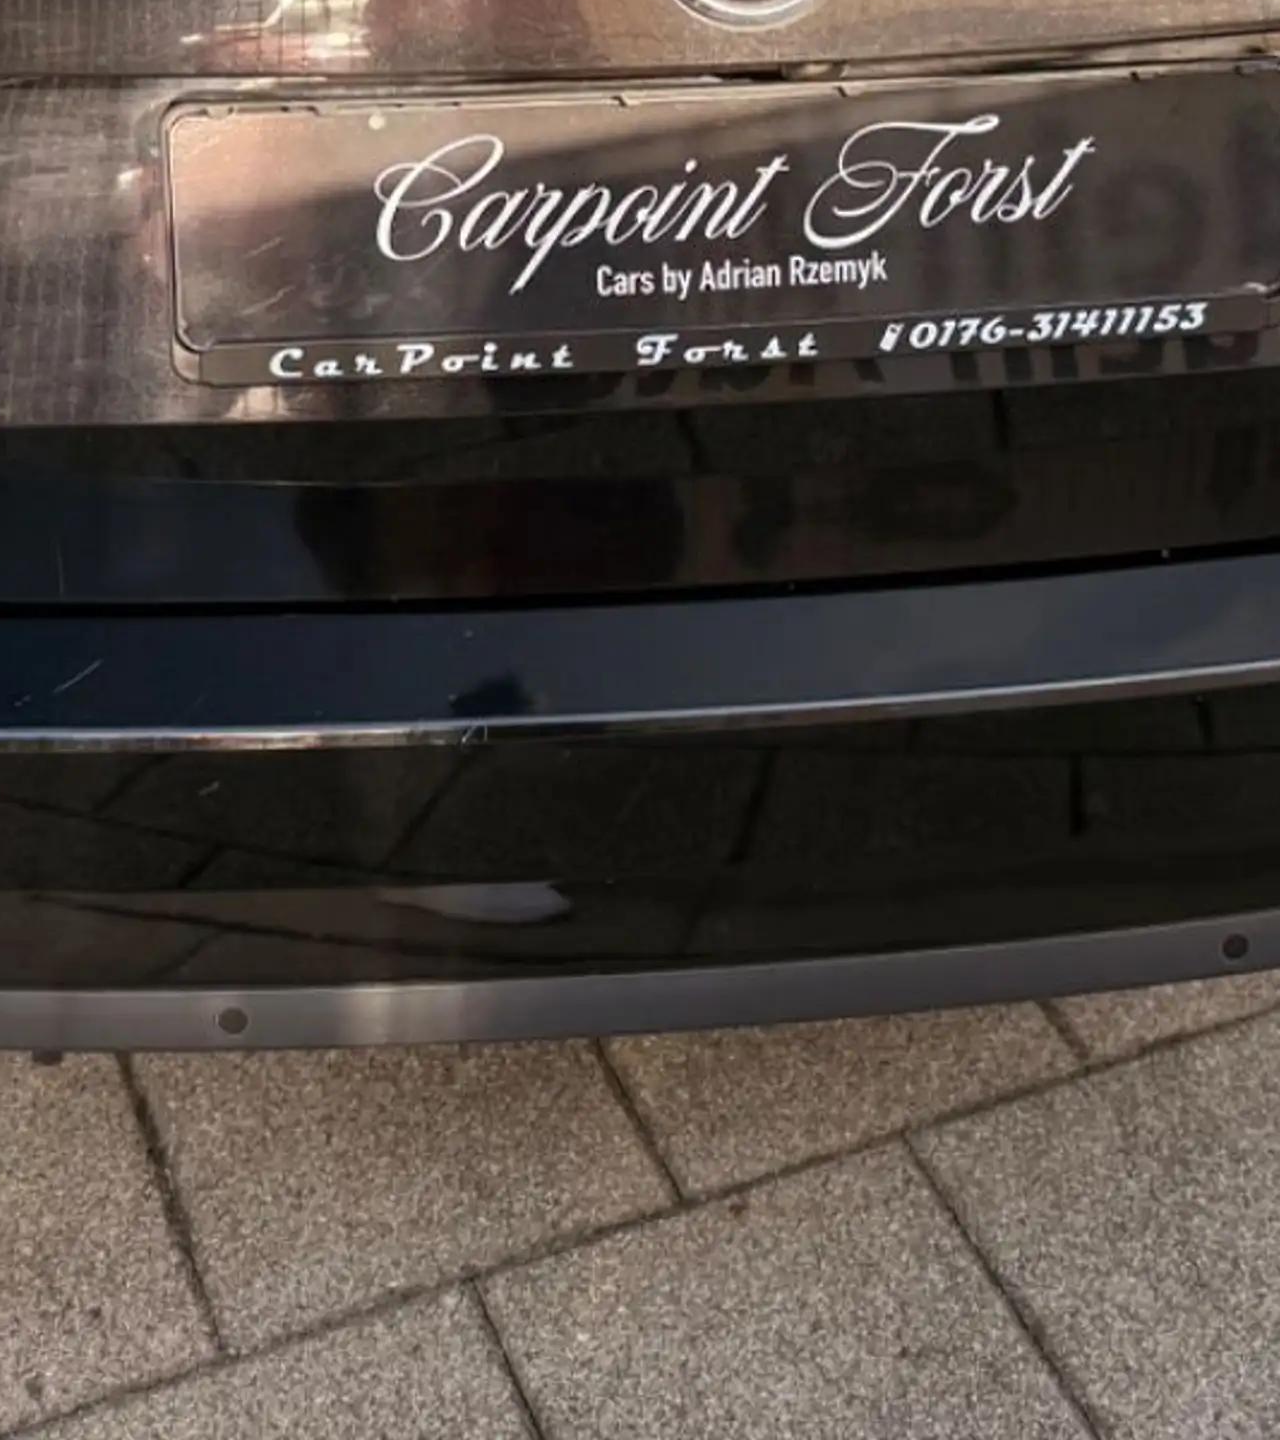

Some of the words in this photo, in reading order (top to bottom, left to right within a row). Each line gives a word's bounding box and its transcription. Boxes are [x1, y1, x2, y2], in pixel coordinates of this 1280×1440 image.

[374, 134, 789, 295] Carpoint
[804, 114, 1095, 249] Forst
[596, 265, 655, 296] Cars
[661, 262, 692, 300] by
[699, 258, 781, 291] Adrian
[788, 251, 888, 289] Rzemyk
[269, 342, 574, 378] CarPoint
[636, 332, 820, 366] Forst
[909, 302, 1208, 349] 0176-31411153
